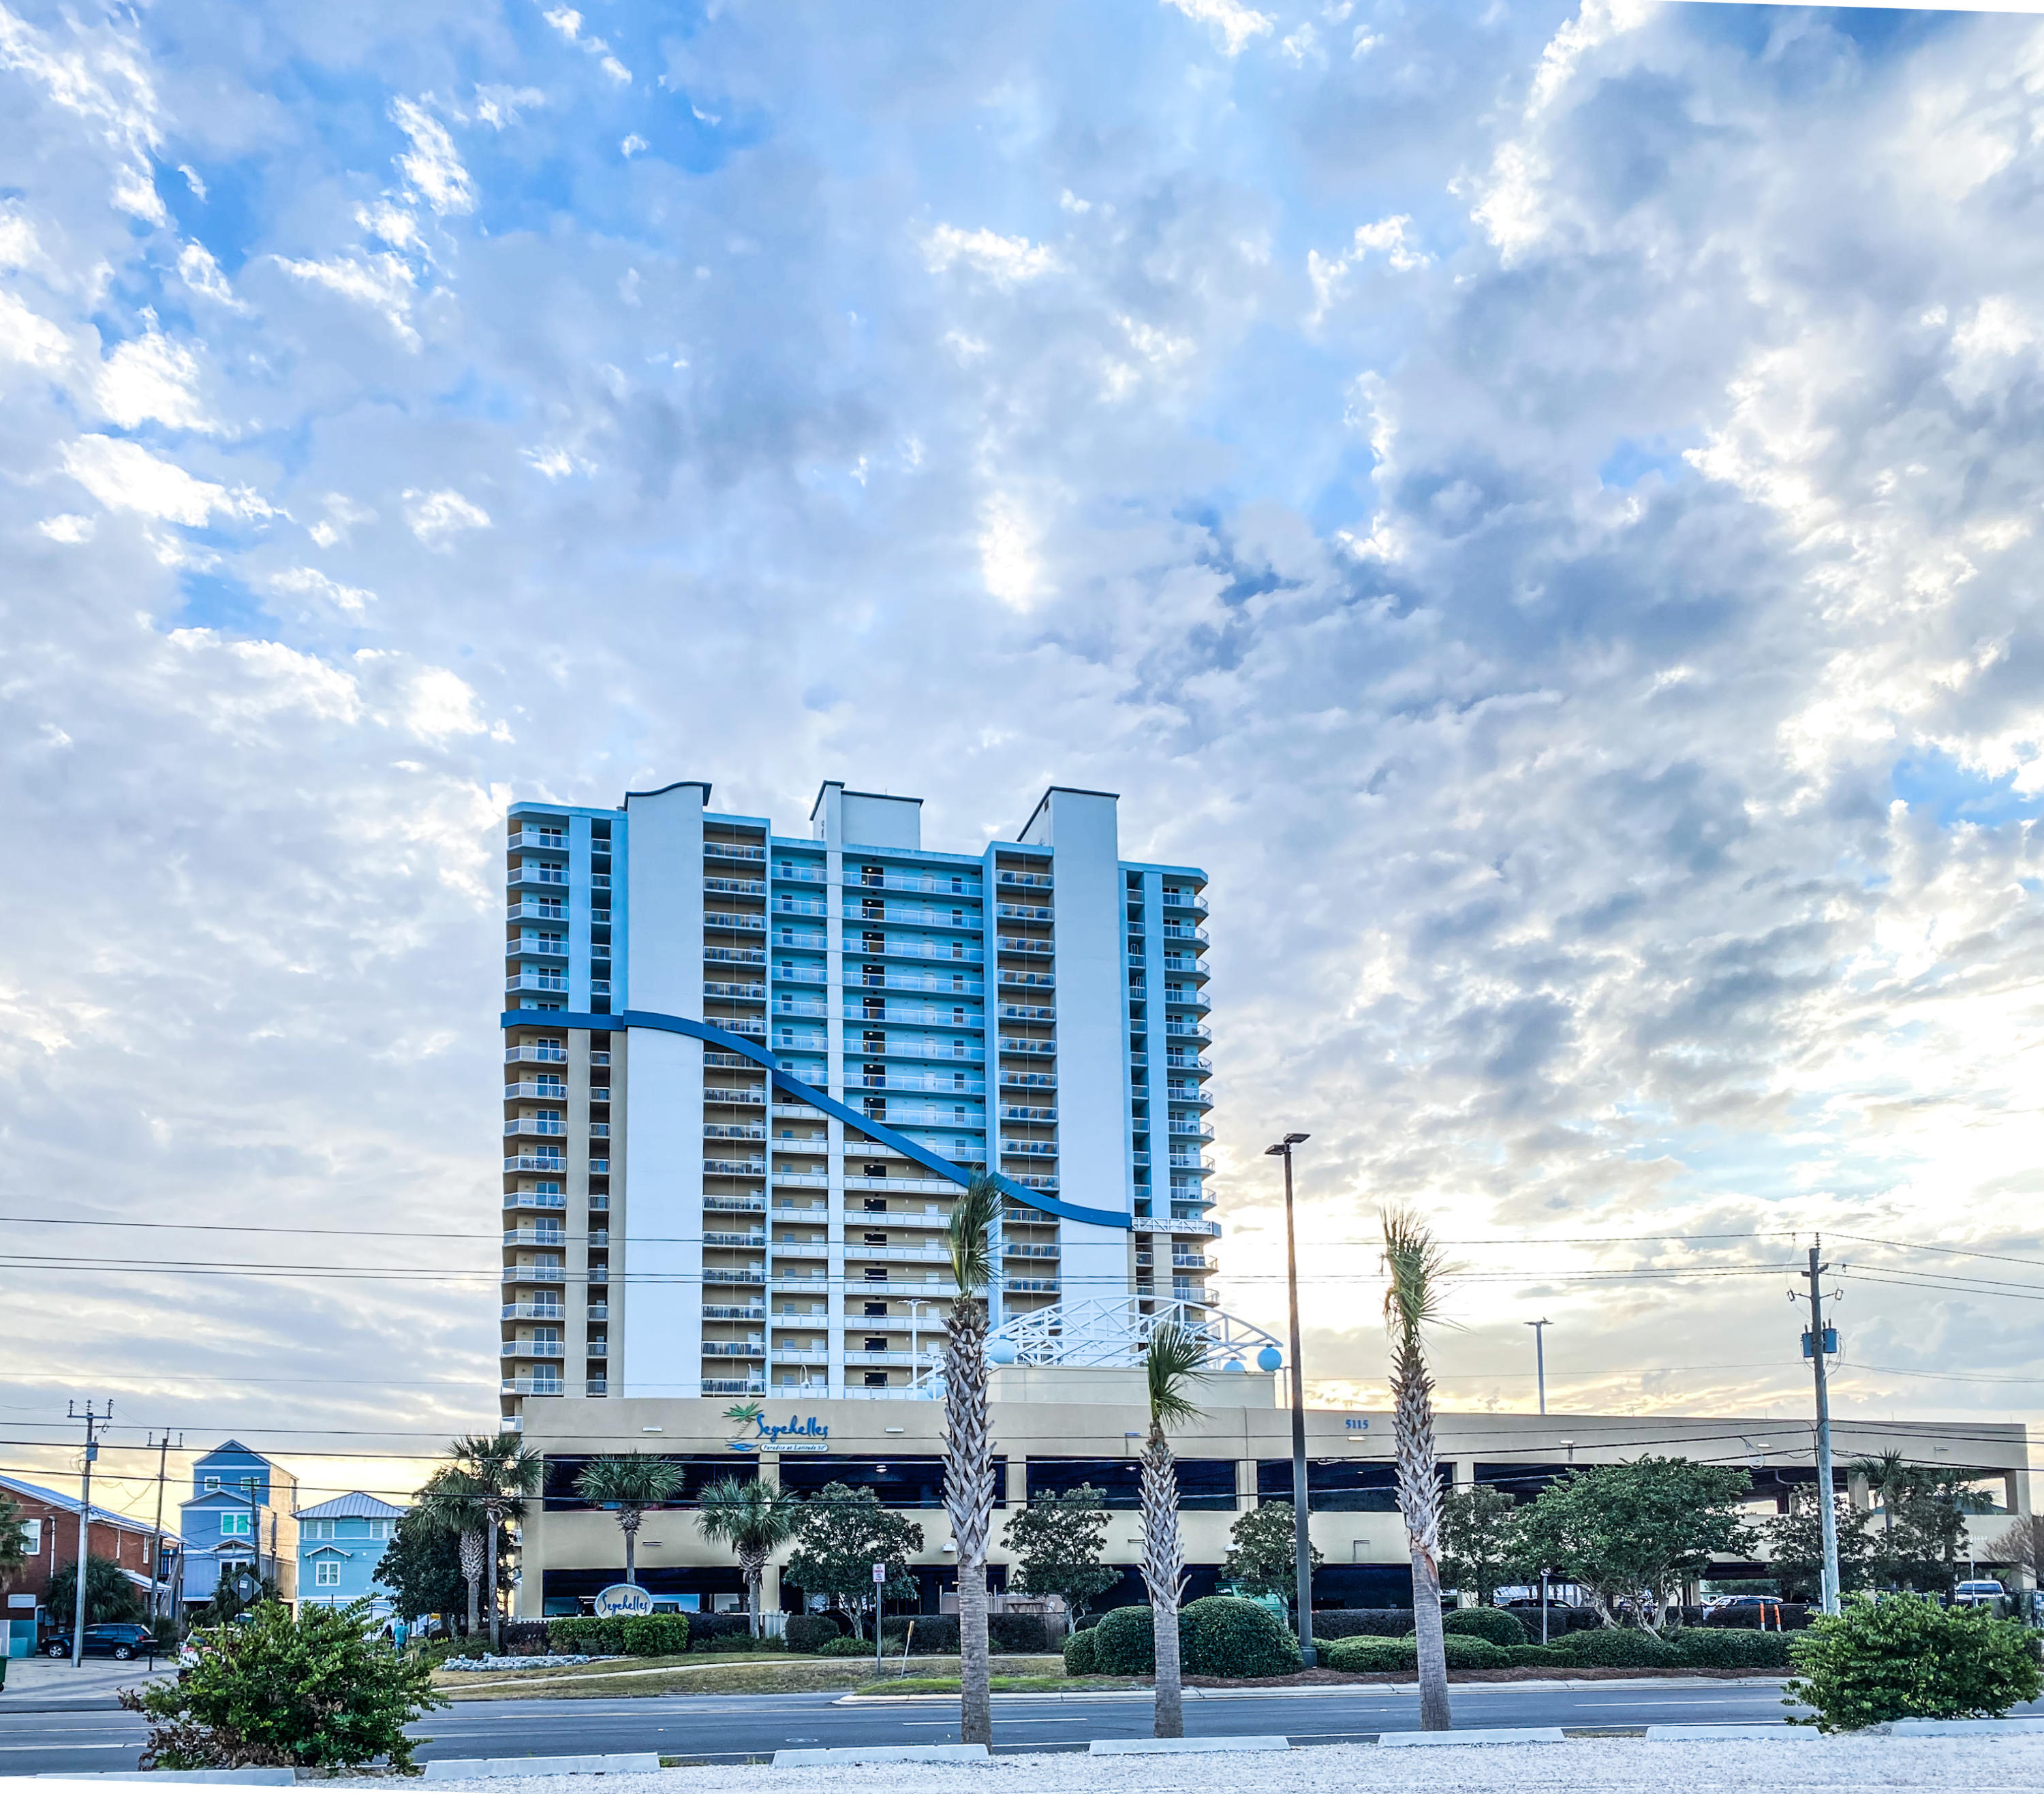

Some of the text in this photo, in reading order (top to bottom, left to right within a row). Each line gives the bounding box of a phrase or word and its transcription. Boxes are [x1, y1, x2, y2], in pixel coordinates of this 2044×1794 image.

[756, 1413, 829, 1443] Seychelles
[1345, 1419, 1369, 1429] 5115
[602, 1594, 648, 1615] Seychelles
